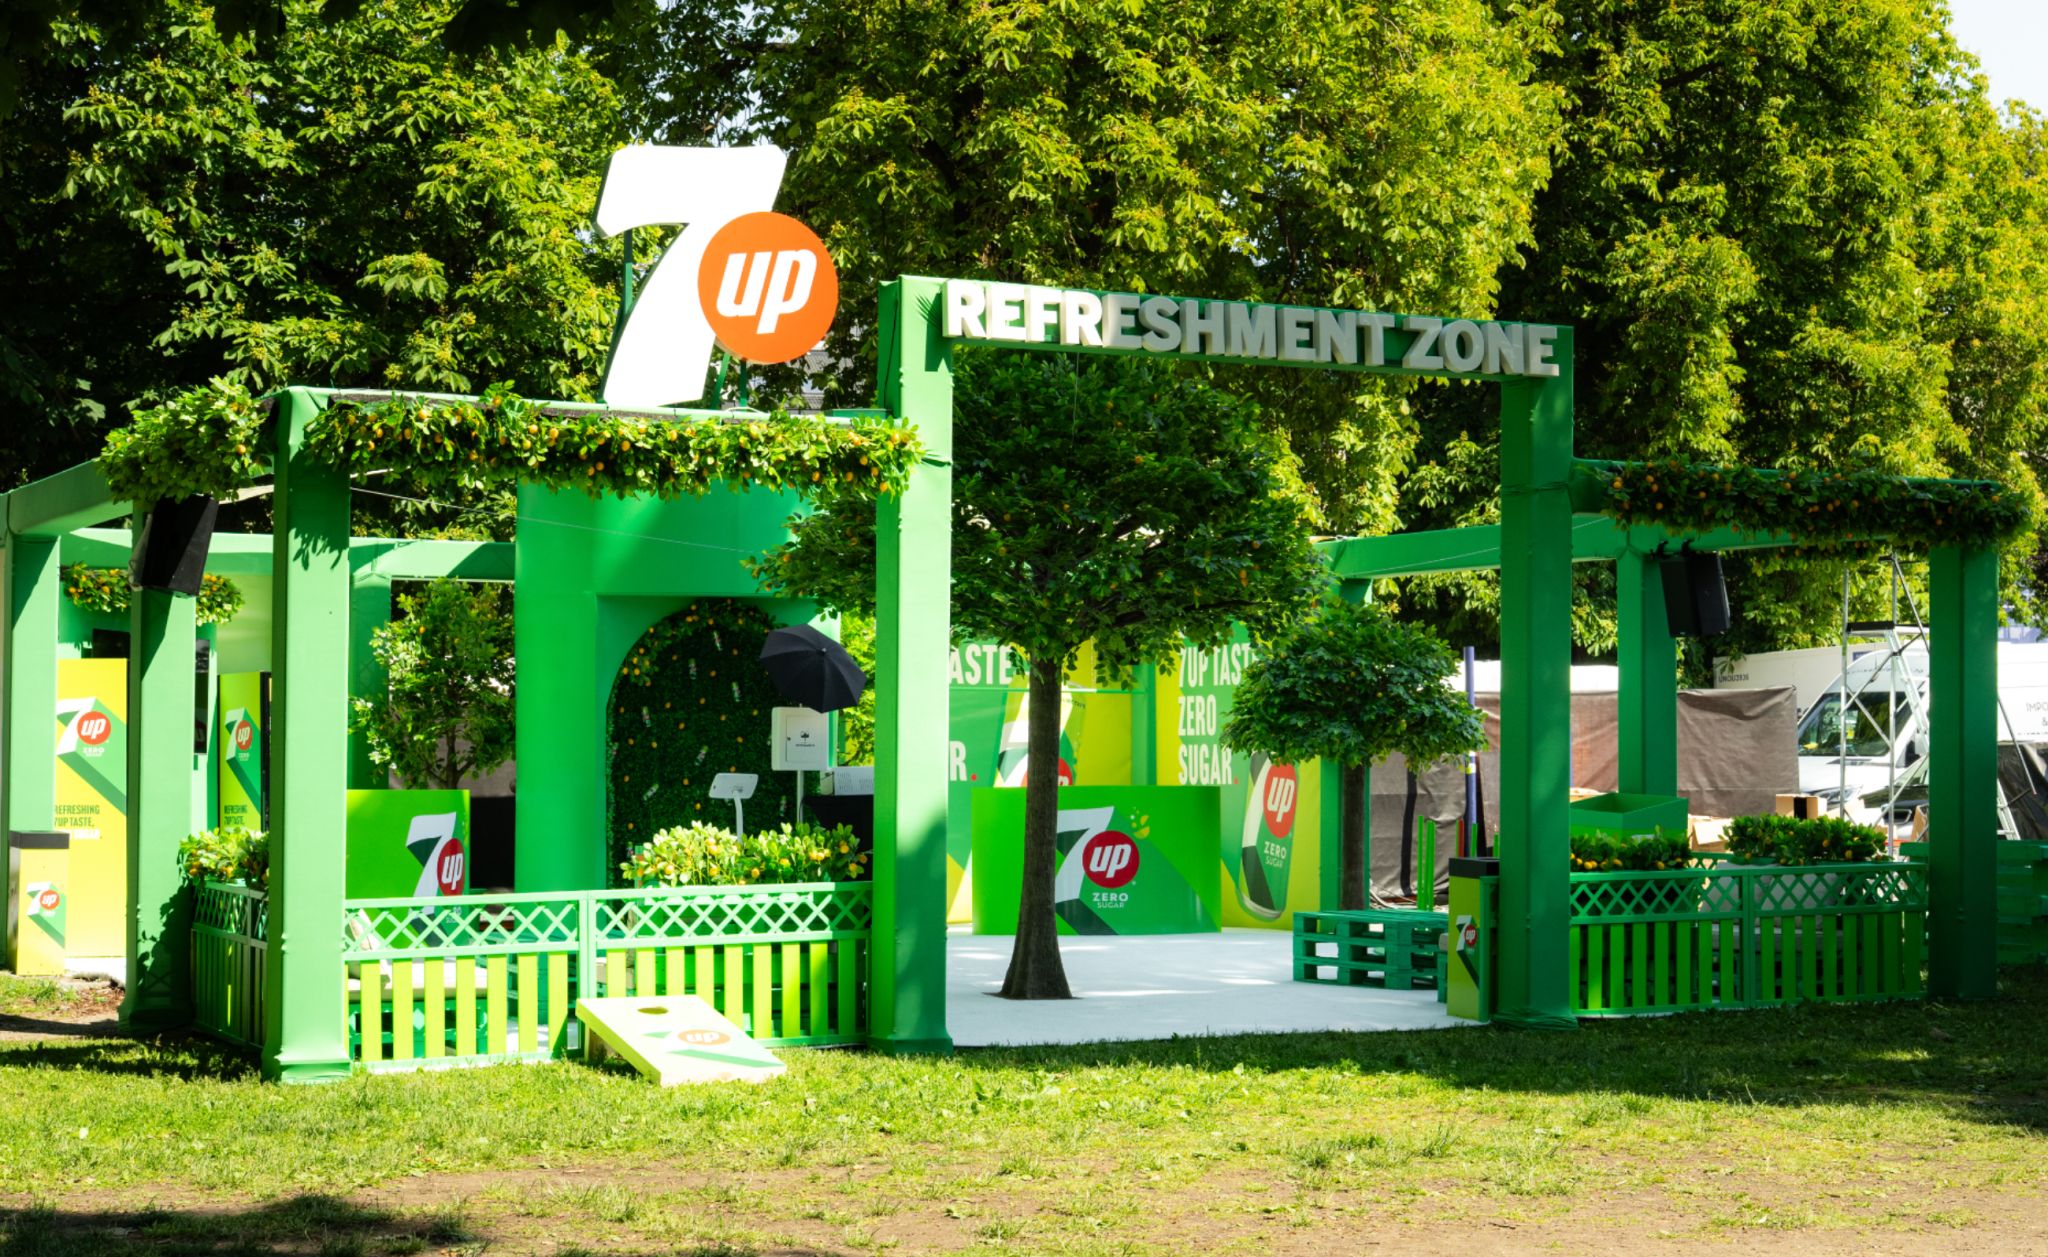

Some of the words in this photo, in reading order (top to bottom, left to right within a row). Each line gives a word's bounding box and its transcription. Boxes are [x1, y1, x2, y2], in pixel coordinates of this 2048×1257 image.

[941, 278, 1395, 366] REFRESHMENT
[1402, 317, 1561, 377] ZONE
[949, 643, 1012, 686] ASTE
[1179, 646, 1209, 688] 7UP
[1213, 643, 1260, 686] TAST
[1178, 694, 1217, 737] ZERO
[1178, 743, 1239, 786] SUGAR.
[1264, 841, 1287, 860] ZERO
[1092, 892, 1129, 902] ZERO
